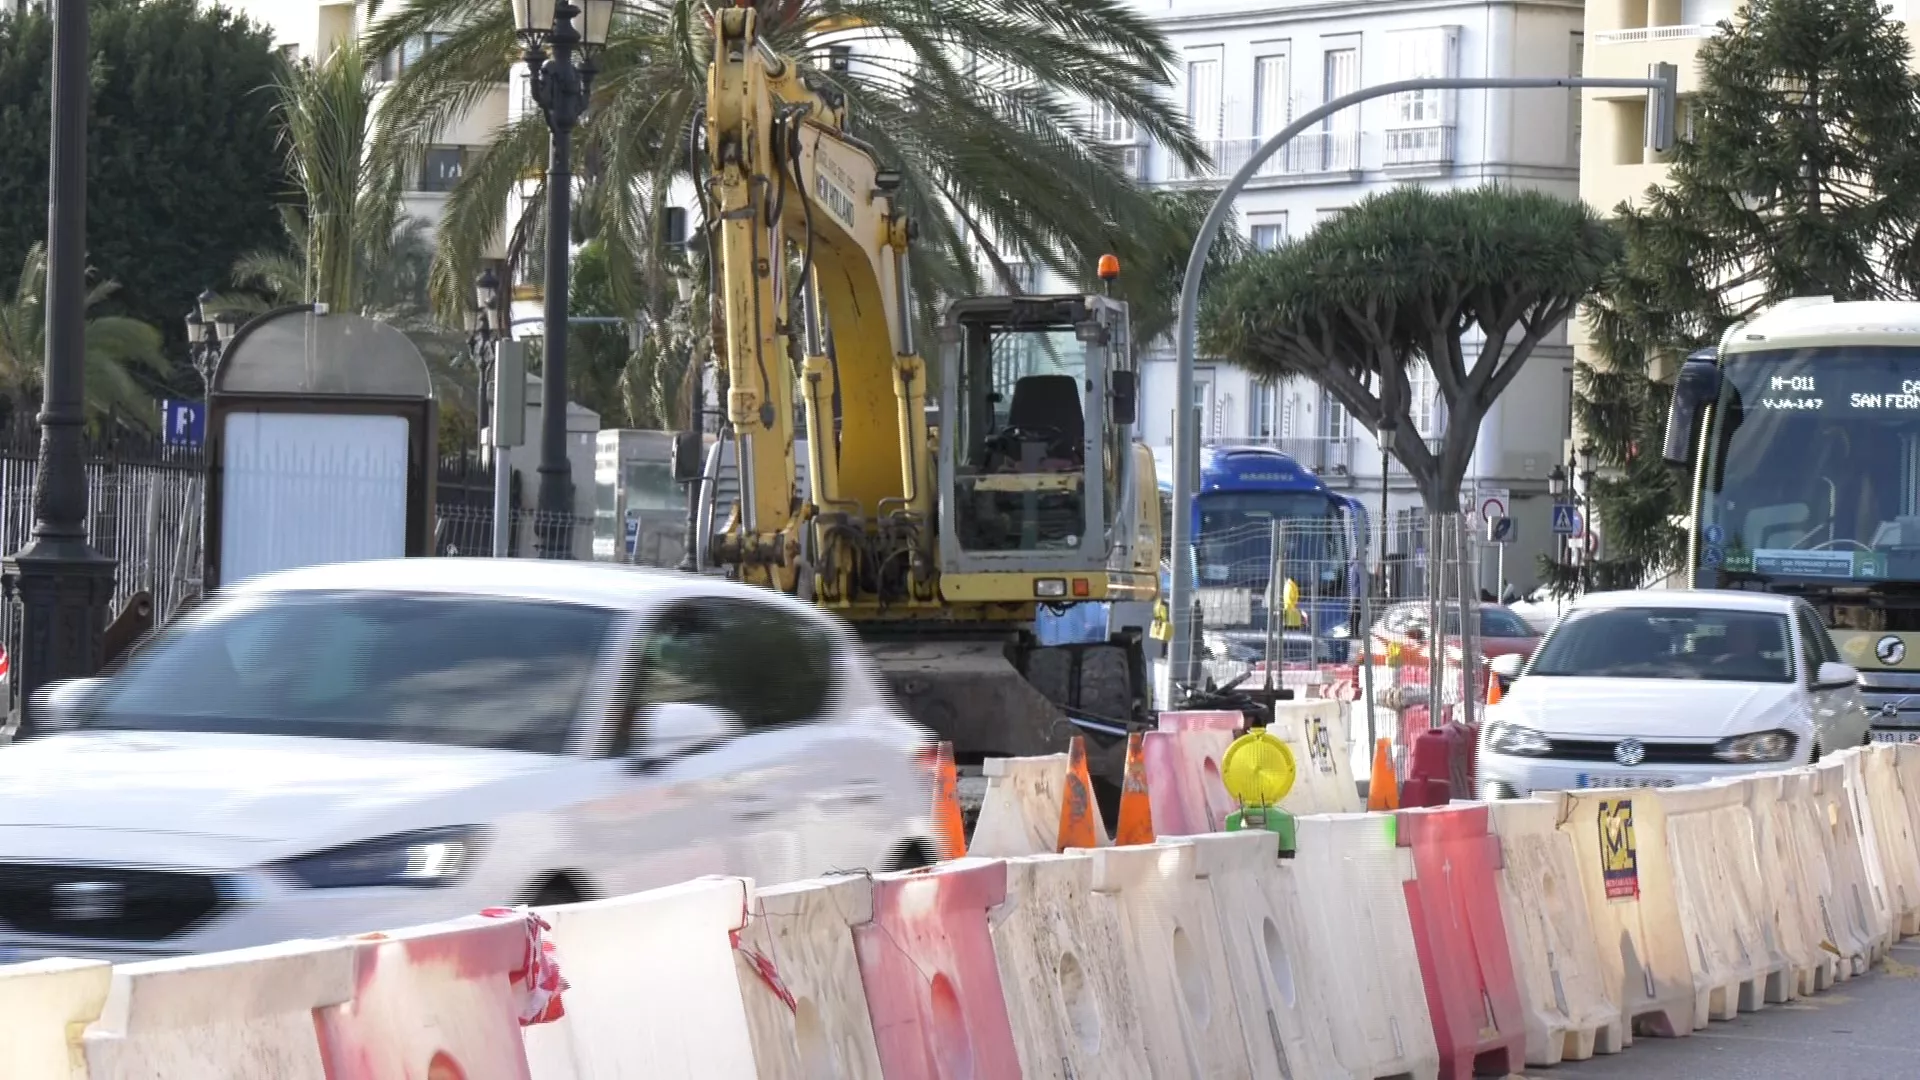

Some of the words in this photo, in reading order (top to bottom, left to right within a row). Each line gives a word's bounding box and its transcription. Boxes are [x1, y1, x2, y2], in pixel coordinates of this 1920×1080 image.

[1771, 376, 1815, 391] M-011
[1762, 398, 1824, 410] VJA-147
[1850, 393, 1882, 408] SAN
[176, 406, 196, 435] P
